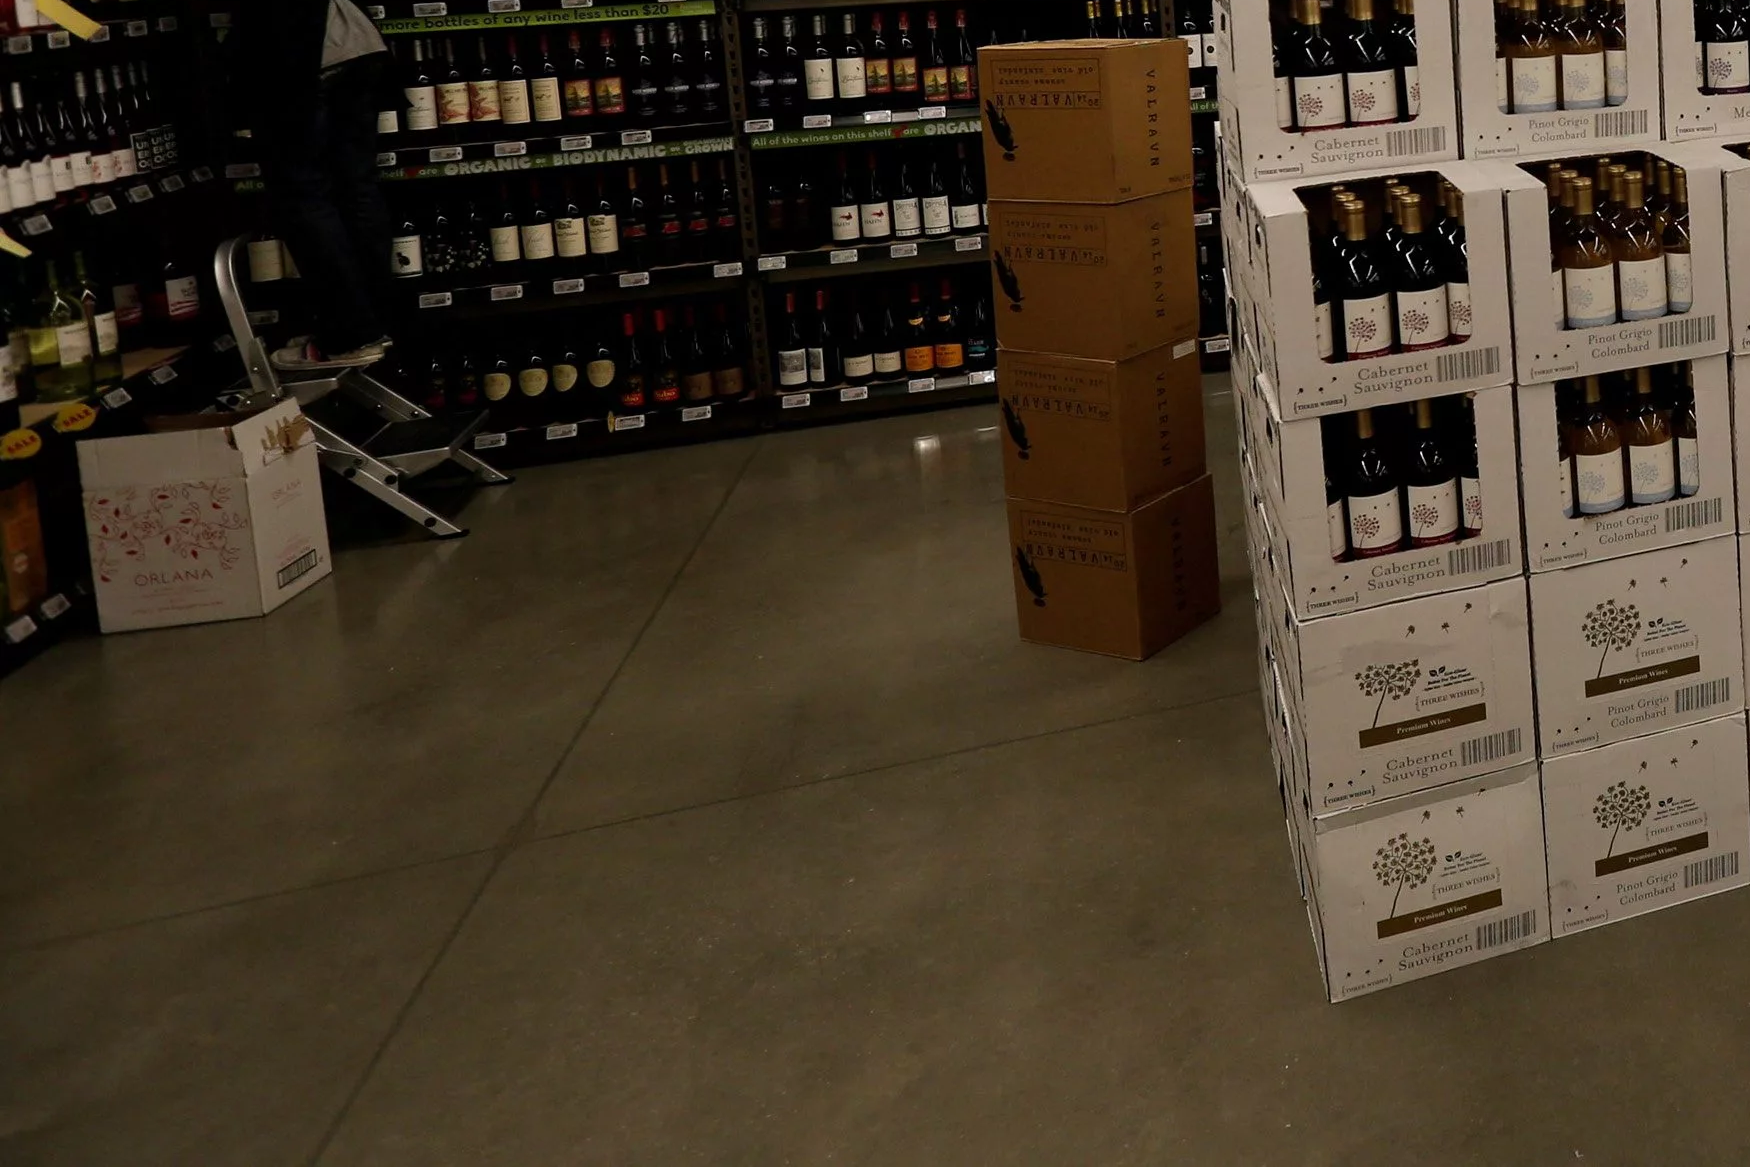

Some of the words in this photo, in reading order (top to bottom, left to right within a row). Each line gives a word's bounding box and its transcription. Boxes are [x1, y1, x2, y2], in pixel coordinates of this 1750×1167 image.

[424, 14, 479, 29] bottles
[484, 13, 500, 26] of
[504, 14, 531, 28] any
[536, 9, 570, 23] wine
[573, 8, 600, 20] less
[605, 5, 637, 18] than
[643, 2, 669, 16] $20
[994, 93, 1071, 108] VALRAVN
[1146, 69, 1160, 167] VALRAVN
[1529, 120, 1555, 130] Pinot
[1557, 117, 1589, 128] Grigio
[753, 137, 767, 146] All
[769, 136, 779, 146] of
[781, 135, 798, 144] the
[800, 132, 830, 143] wines
[833, 132, 845, 141] on
[847, 130, 866, 140] this
[867, 127, 891, 138] shelf
[903, 126, 919, 135] are
[924, 120, 982, 136] ORGAN
[1532, 129, 1587, 143] Colombard
[685, 141, 734, 154] GROWN
[1314, 136, 1380, 151] Cabernet
[444, 155, 531, 175] ORGANIC
[553, 145, 666, 167] BIODYNAMIC
[1311, 148, 1383, 164] Sauvignon
[1003, 246, 1079, 262] VALRAVN
[1150, 222, 1165, 319] VALRAVN
[1588, 334, 1616, 345] Pinot
[1619, 327, 1653, 341] Grigio
[1591, 341, 1650, 359] Colombard
[1358, 361, 1429, 380] Cabernet
[1353, 374, 1434, 395] Sauvignon
[1011, 395, 1082, 412] VALRAVN
[62, 408, 91, 428] SALE
[1156, 372, 1172, 468] VALRAVN
[7, 434, 36, 453] SALE
[1595, 520, 1623, 532] Pinot
[1626, 513, 1660, 528] Grigio
[1598, 525, 1658, 545] Colombard
[1371, 557, 1441, 577] Cabernet
[135, 568, 214, 587] ORLANA
[1367, 568, 1446, 592] Sauvignon
[1619, 675, 1648, 685] Premium
[1649, 668, 1669, 678] Wines
[1420, 696, 1447, 706] THREE
[1450, 688, 1480, 700] WISHES
[1607, 705, 1635, 716] Pinot
[1638, 696, 1669, 711] Grigio
[1396, 723, 1429, 735] Premium
[1429, 716, 1452, 727] Wines
[1611, 707, 1667, 729] Colombard
[1386, 748, 1454, 771] Cabernet
[1382, 759, 1458, 784] Sauvignon
[1437, 884, 1464, 894] THREE
[1466, 874, 1496, 887] WISHES
[1616, 883, 1643, 894] Pinot
[1646, 871, 1678, 887] Grigio
[1619, 884, 1676, 906] Colombard
[1414, 911, 1445, 924] Premium
[1446, 903, 1468, 915] Wines
[1402, 932, 1469, 958] Cabernet
[1397, 943, 1473, 971] Sauvignon
